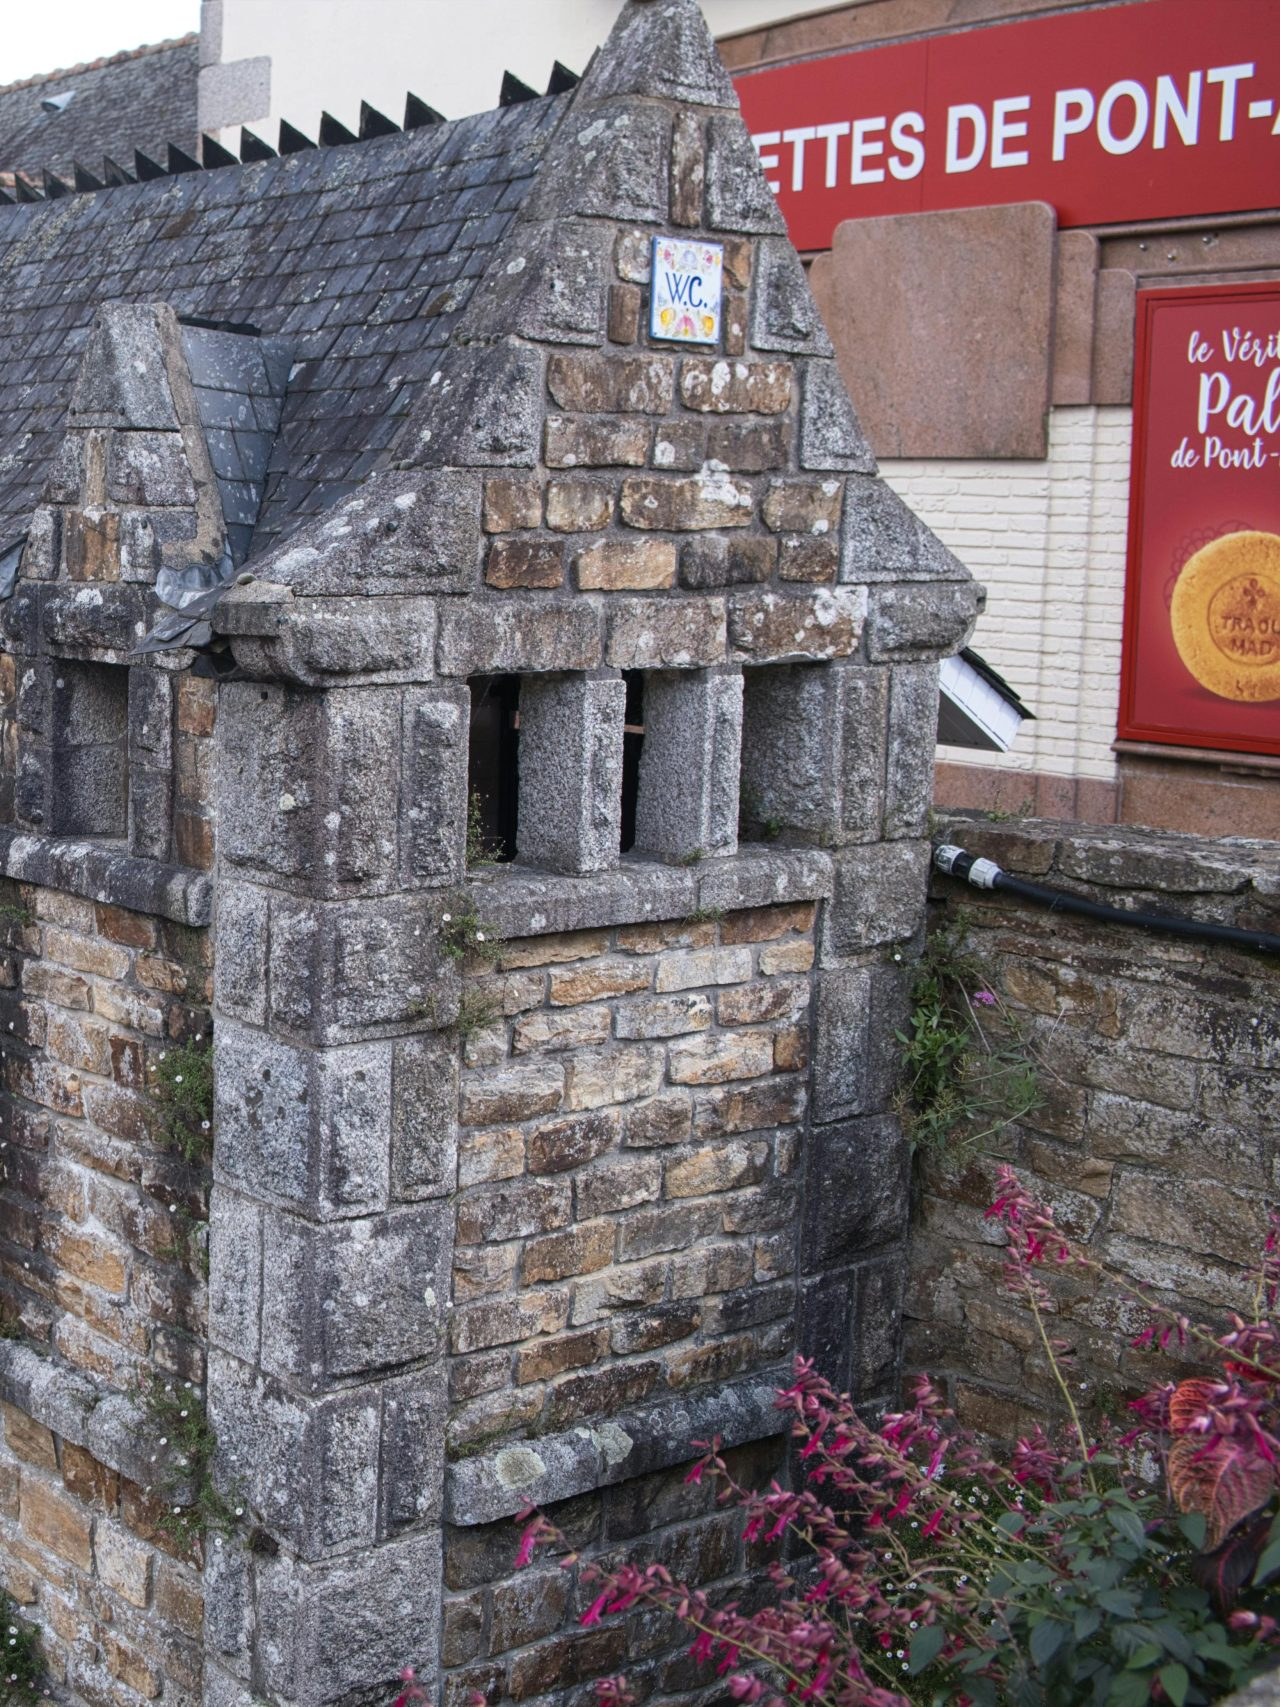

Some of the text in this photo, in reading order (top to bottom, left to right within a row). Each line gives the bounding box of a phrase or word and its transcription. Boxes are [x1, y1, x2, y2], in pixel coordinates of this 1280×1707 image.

[945, 95, 1031, 174] DE
[1052, 62, 1280, 161] PONT-
[665, 271, 708, 309] W.C.
[1188, 330, 1214, 363] le
[1171, 436, 1280, 470] de Pont-
[1231, 637, 1272, 656] MAD
